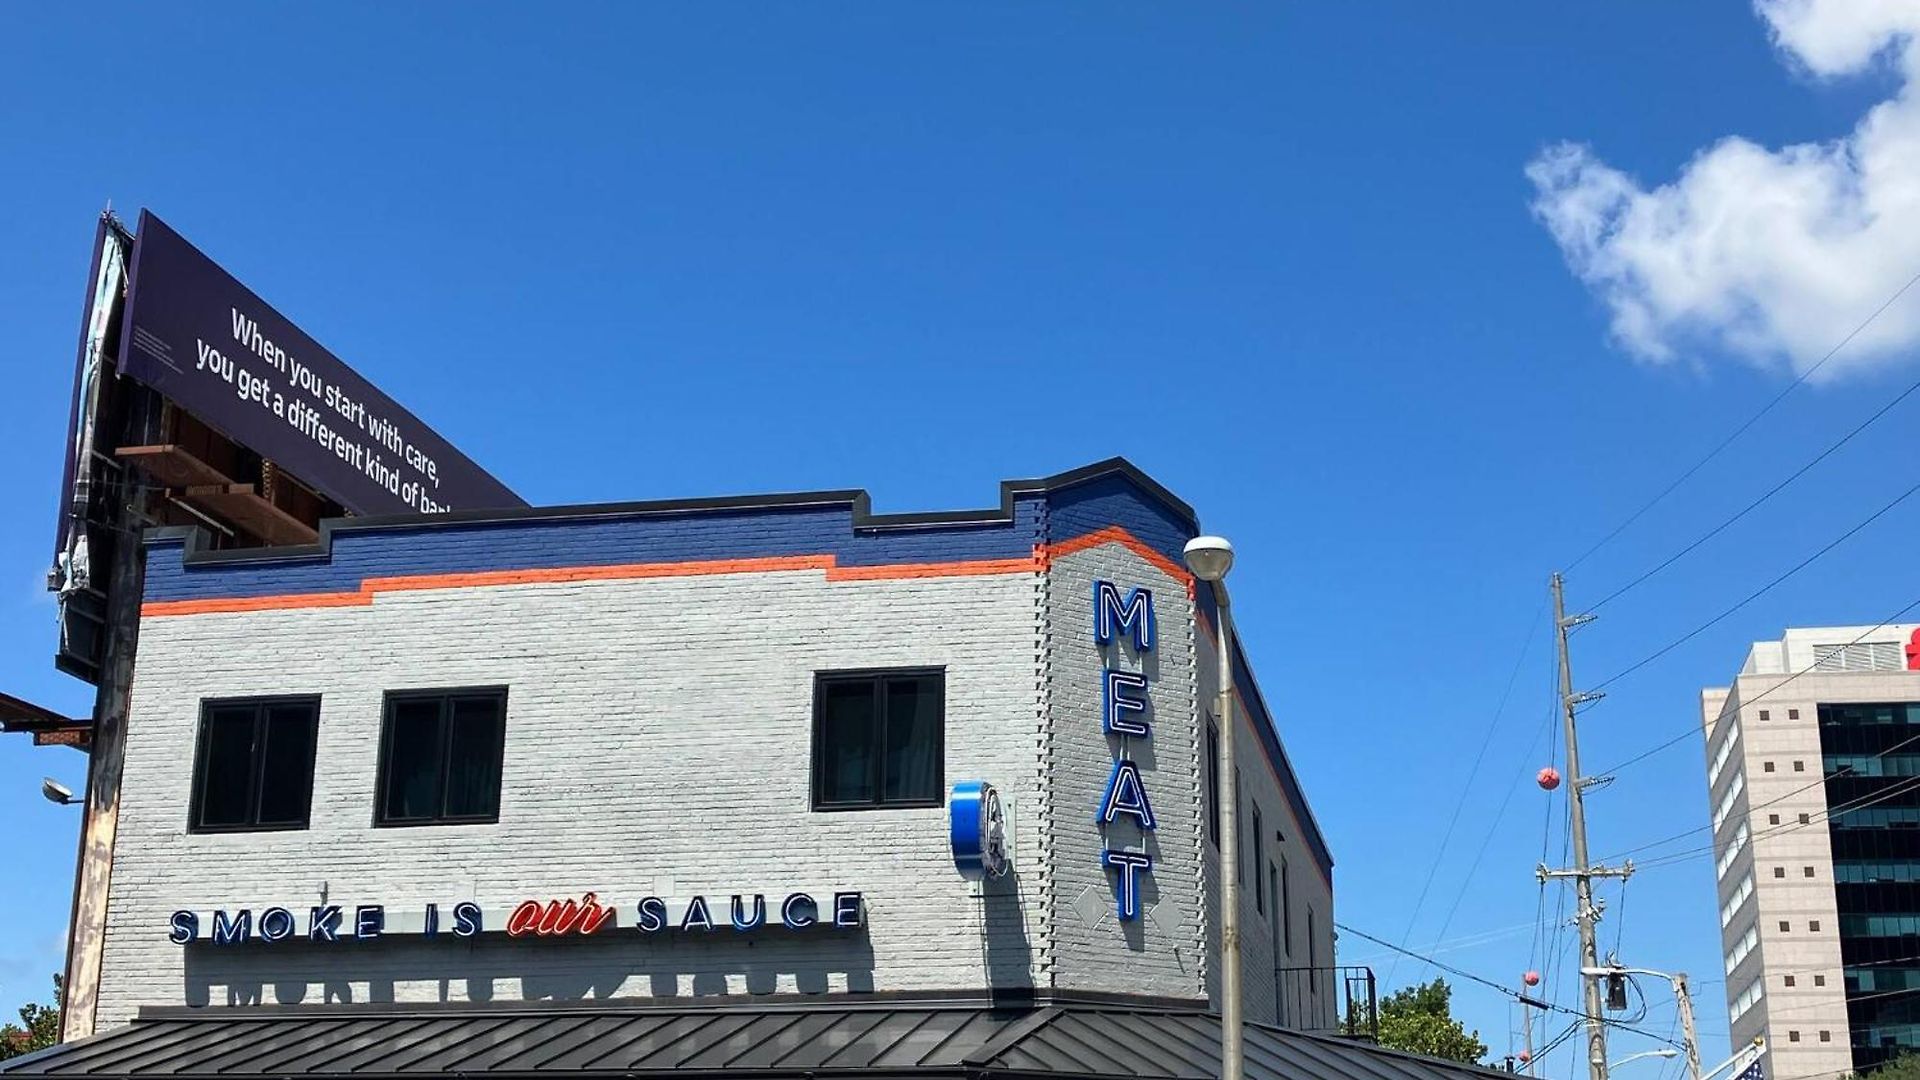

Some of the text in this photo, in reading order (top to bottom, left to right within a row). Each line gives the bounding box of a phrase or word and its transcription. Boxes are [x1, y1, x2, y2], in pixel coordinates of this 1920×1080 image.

[196, 338, 234, 384] you
[237, 368, 271, 408] get
[272, 392, 284, 419] a
[287, 398, 364, 471] different
[365, 447, 400, 496] kind
[401, 481, 419, 508] of
[231, 307, 286, 373] When
[289, 357, 322, 399] you
[324, 384, 366, 430] start
[368, 414, 403, 457] with
[405, 444, 440, 489] care,
[1093, 579, 1156, 921] MEAT
[169, 891, 863, 945] SMOKE IS our SAUCE
